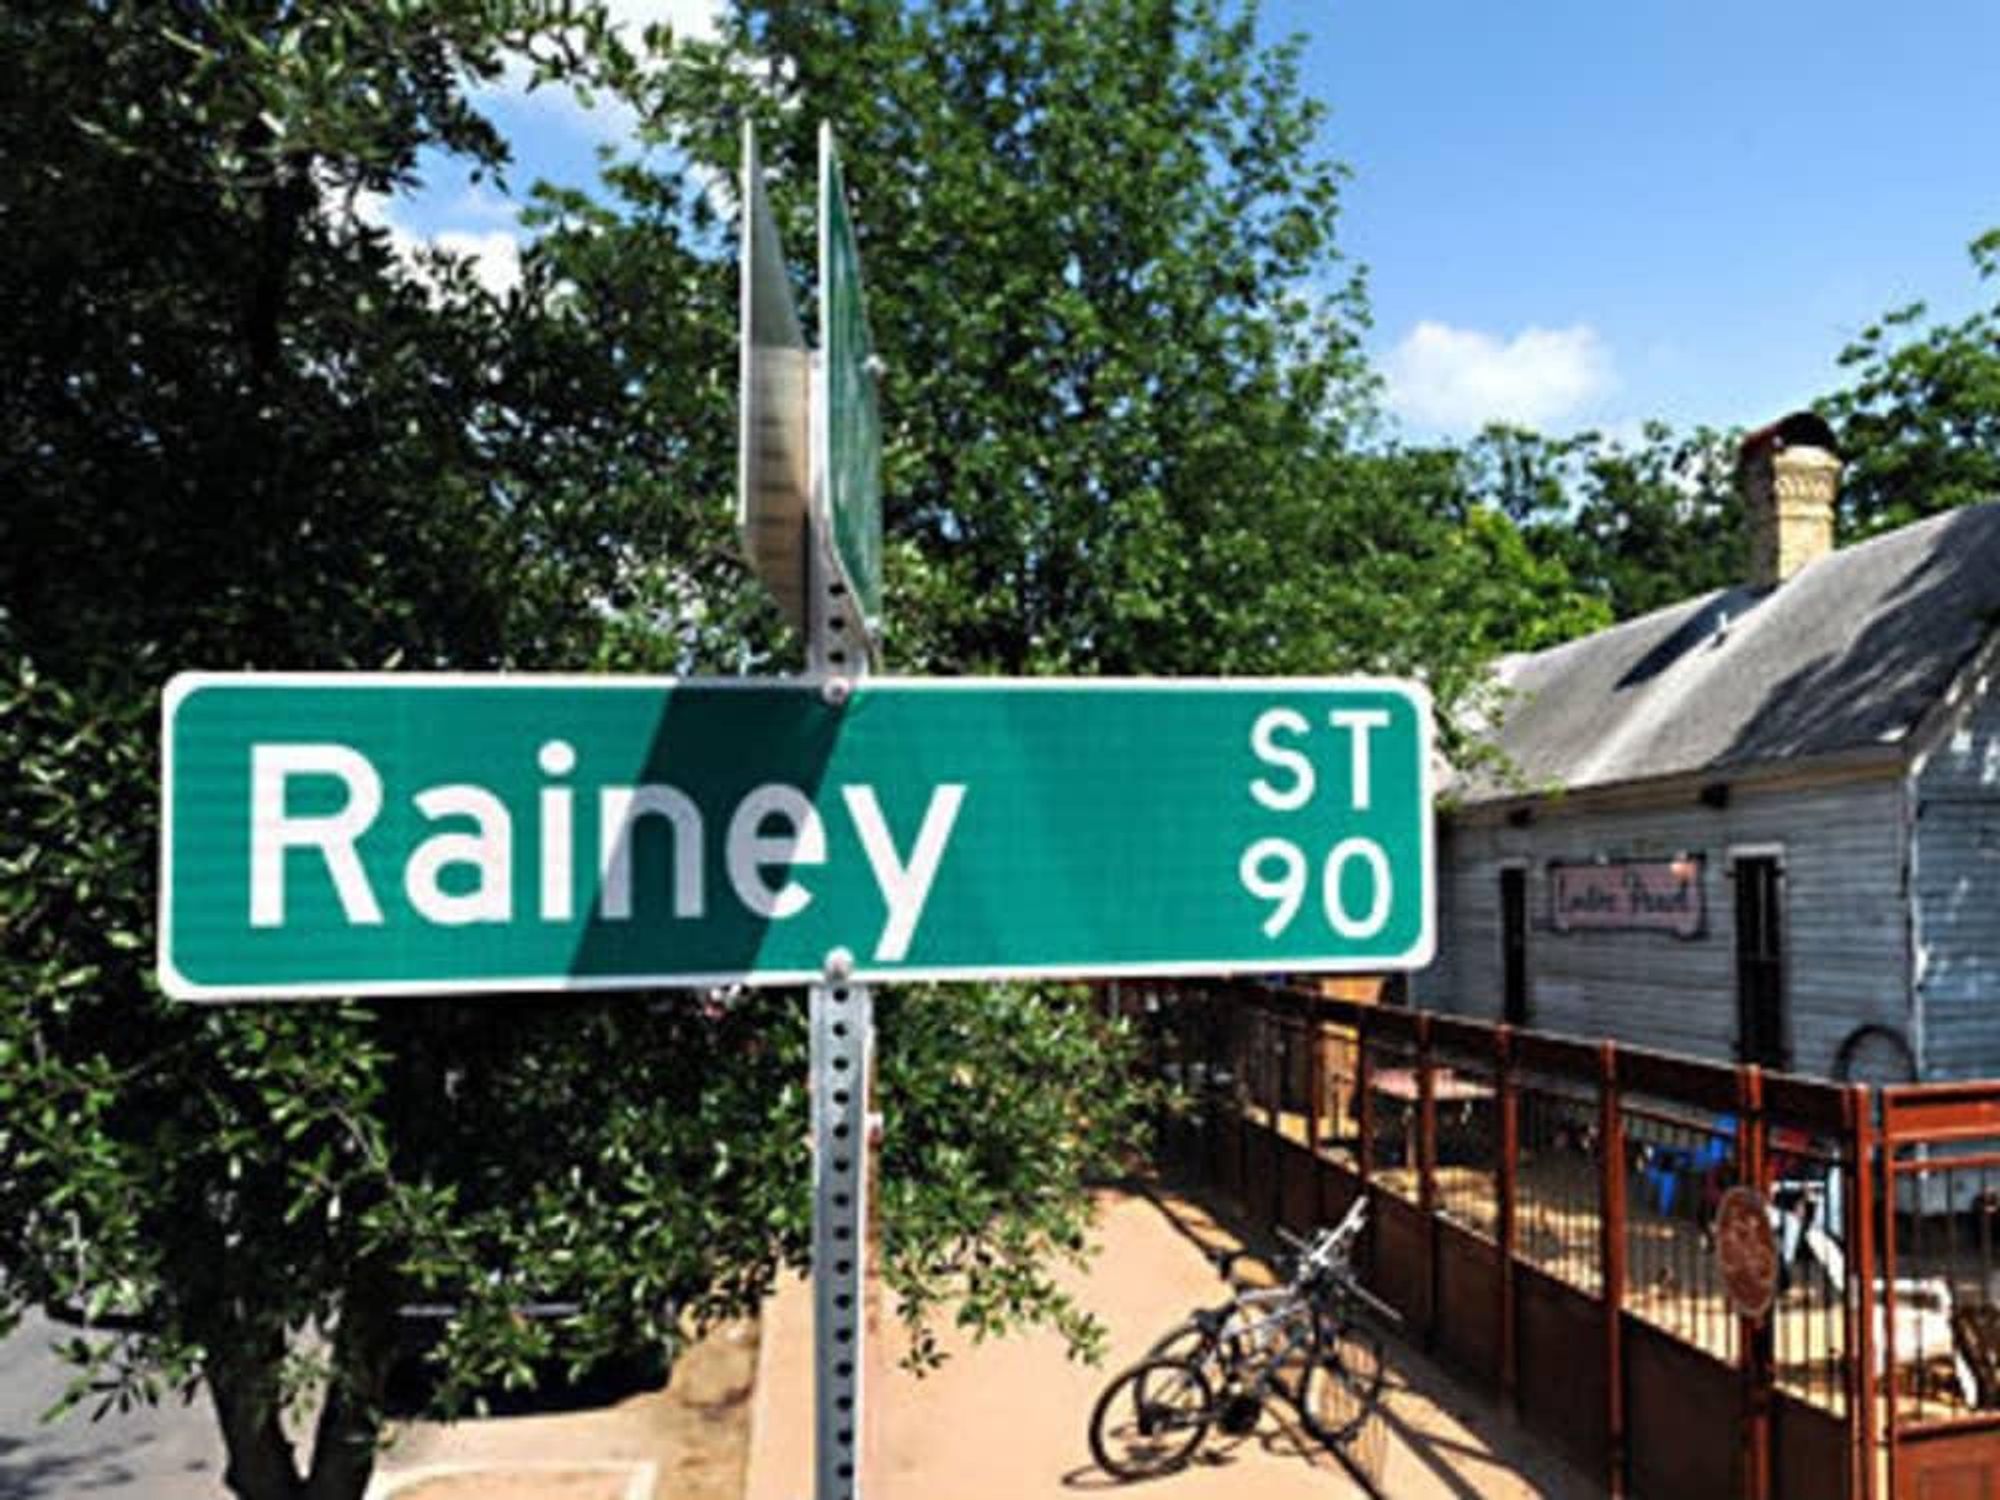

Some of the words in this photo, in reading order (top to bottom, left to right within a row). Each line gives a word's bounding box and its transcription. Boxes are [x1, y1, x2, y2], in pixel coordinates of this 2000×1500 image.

[1250, 707, 1391, 811] ST
[249, 743, 967, 962] Rainey
[1239, 837, 1393, 939] 90
